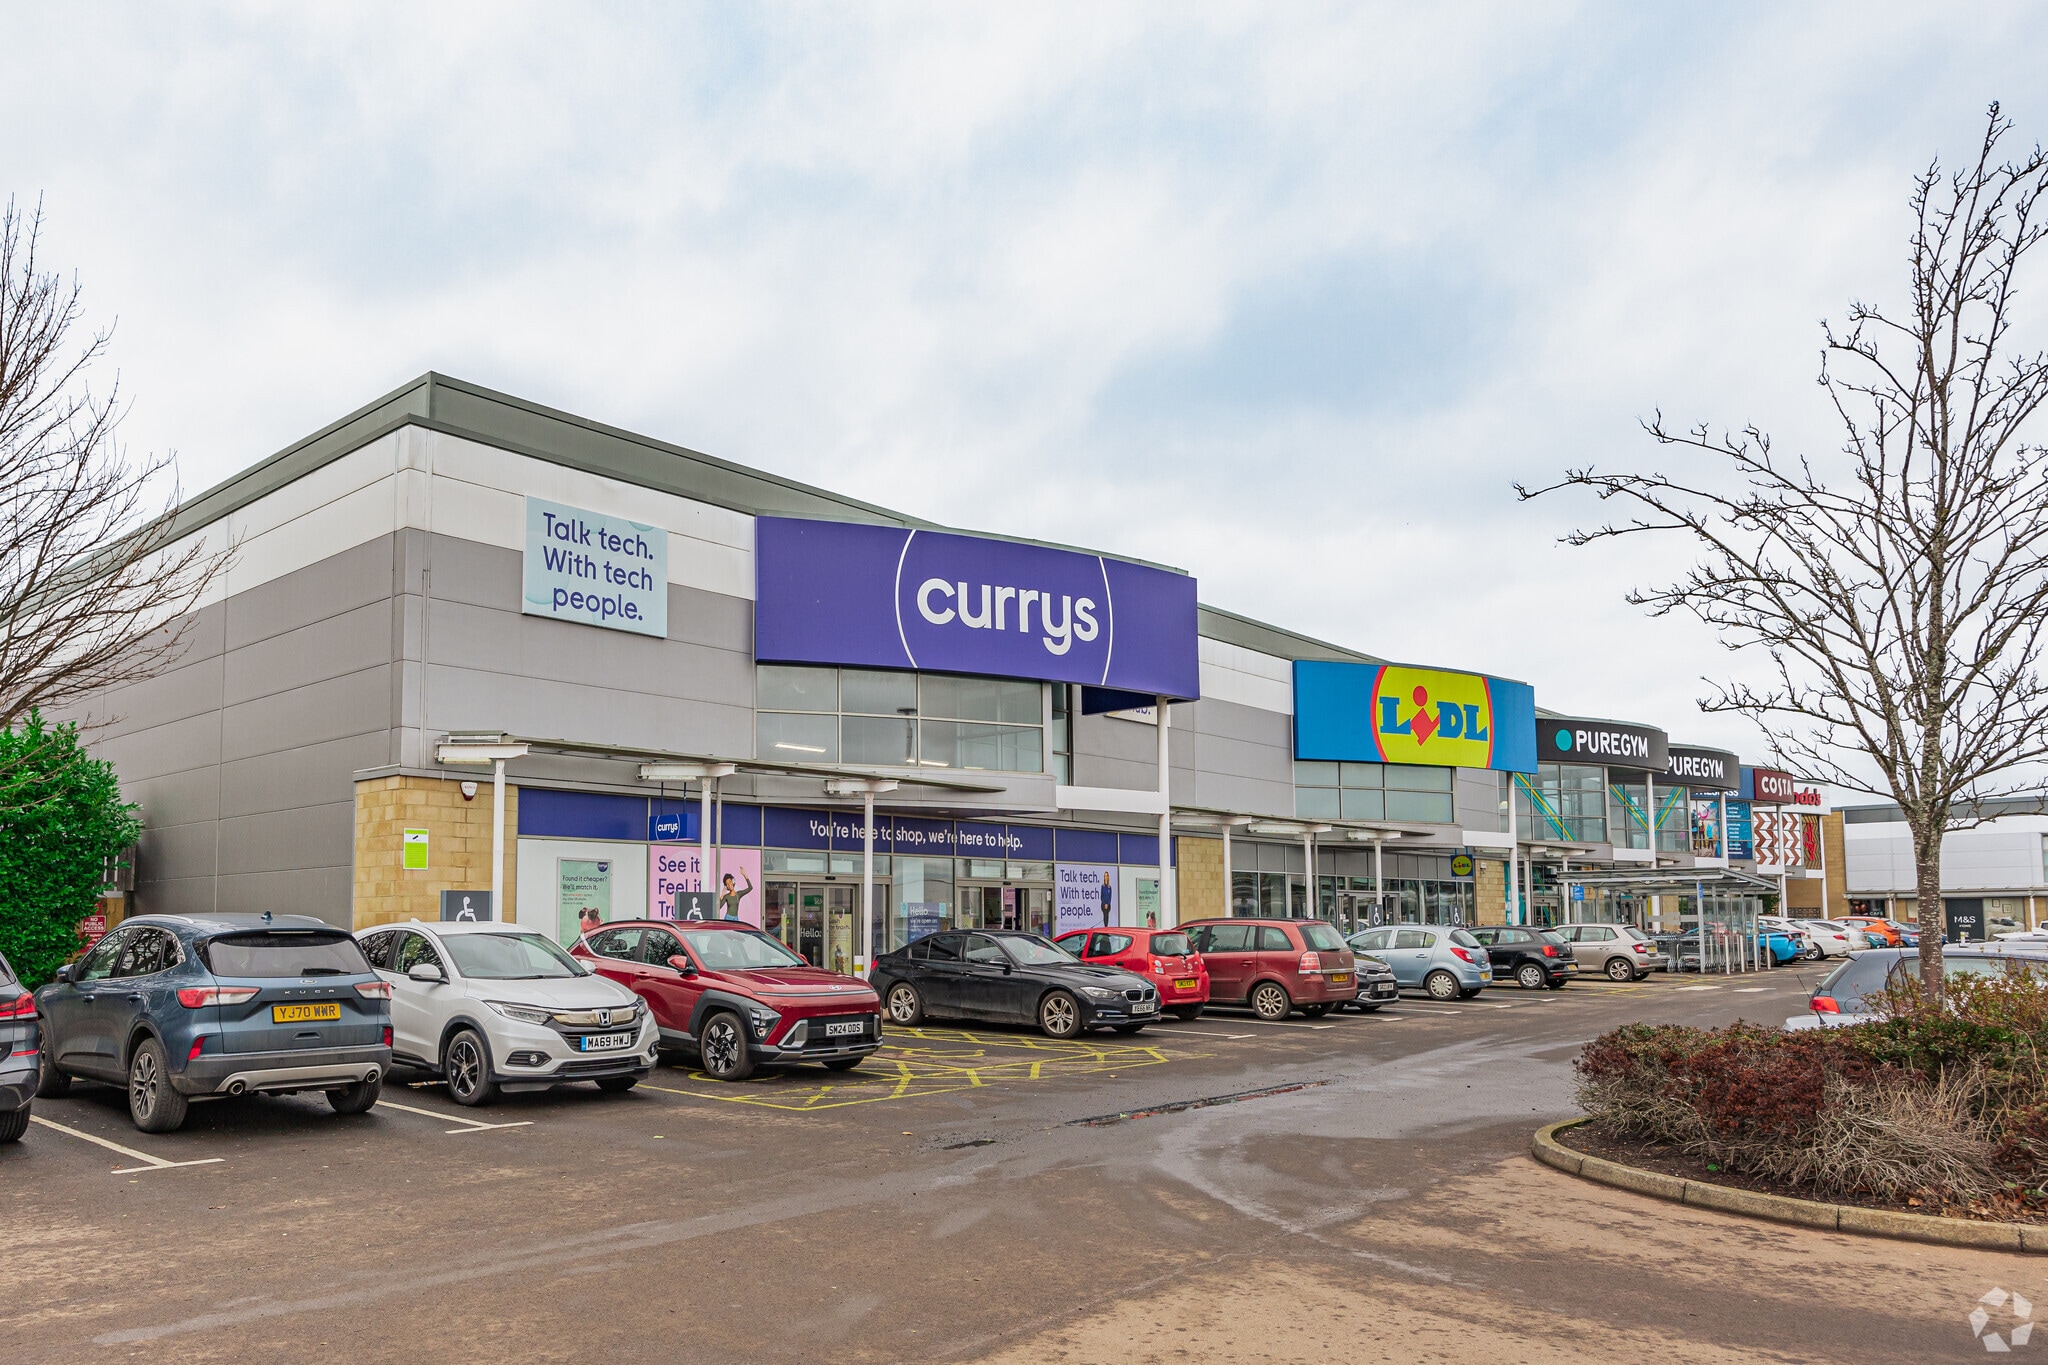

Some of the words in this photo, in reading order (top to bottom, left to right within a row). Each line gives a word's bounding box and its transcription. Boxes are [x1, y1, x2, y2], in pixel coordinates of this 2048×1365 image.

[543, 512, 591, 546] Talk
[599, 528, 653, 560] tech.
[543, 545, 596, 579] With
[604, 561, 652, 591] tech
[553, 588, 643, 621] people.
[916, 578, 1099, 656] currys
[1575, 730, 1649, 758] PUREGYM
[1761, 776, 1792, 797] COSTA
[657, 822, 678, 834] currys
[810, 820, 849, 838] You're
[852, 822, 878, 840] hee
[896, 826, 926, 845] shop,
[928, 829, 957, 844] we're
[960, 830, 982, 845] here
[985, 833, 996, 847] to
[998, 832, 1023, 851] help.
[658, 855, 687, 873] See
[1060, 870, 1077, 882] Talk
[1079, 871, 1100, 883] tech.
[658, 878, 688, 895] Feel
[1060, 886, 1080, 899] With
[1081, 887, 1099, 900] tech
[1060, 904, 1093, 919] people.
[1954, 915, 1976, 924] M&S
[279, 1006, 311, 1019] YJ70
[314, 1005, 336, 1017] WWR
[829, 1024, 846, 1034] SM24
[587, 1036, 611, 1048] MA69
[613, 1034, 630, 1046] HWJ
